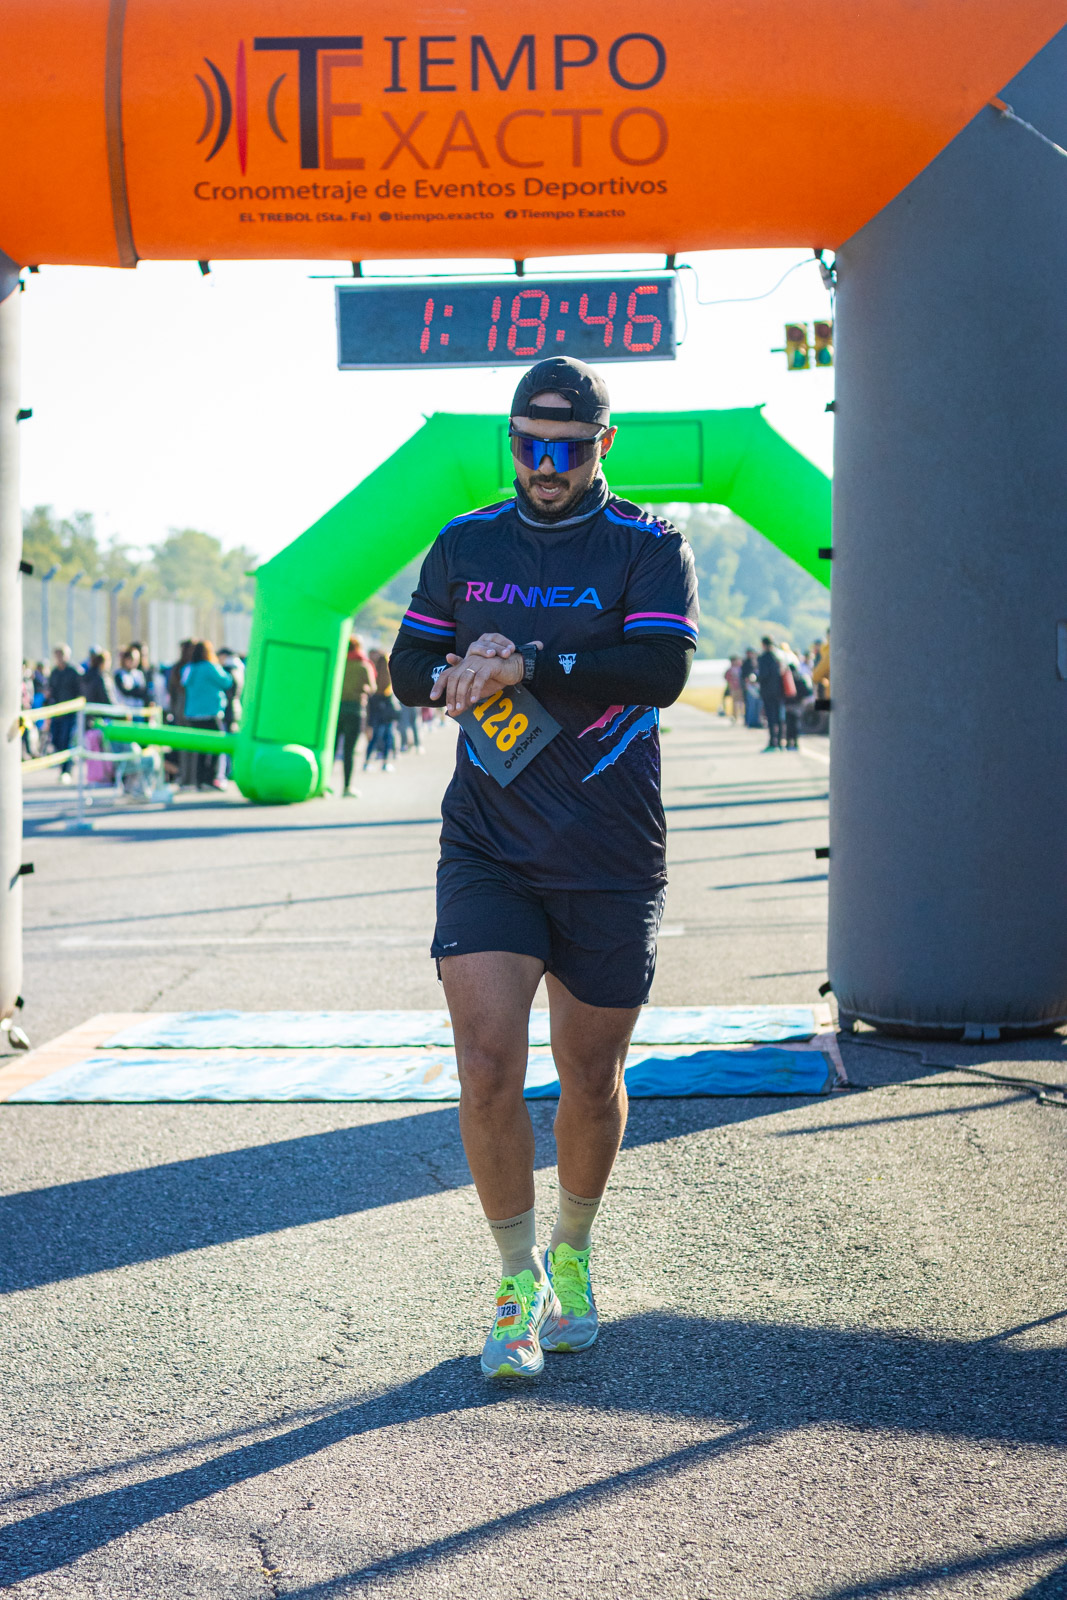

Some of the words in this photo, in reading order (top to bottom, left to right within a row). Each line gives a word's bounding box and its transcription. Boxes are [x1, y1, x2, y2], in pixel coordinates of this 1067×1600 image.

[322, 54, 670, 170] EXACTO
[194, 181, 368, 203] Cronometraje
[374, 179, 407, 199] de
[414, 179, 516, 199] Eventos
[523, 177, 668, 200] Deportivos
[239, 212, 255, 222] EL
[259, 212, 312, 222] TREBOL
[350, 211, 372, 222] Fe)
[520, 208, 575, 220] Tiempo
[578, 207, 627, 219] Exacto
[465, 581, 603, 610] RUNNEA
[503, 725, 543, 769] EXACTO
[500, 1304, 517, 1317] 728
